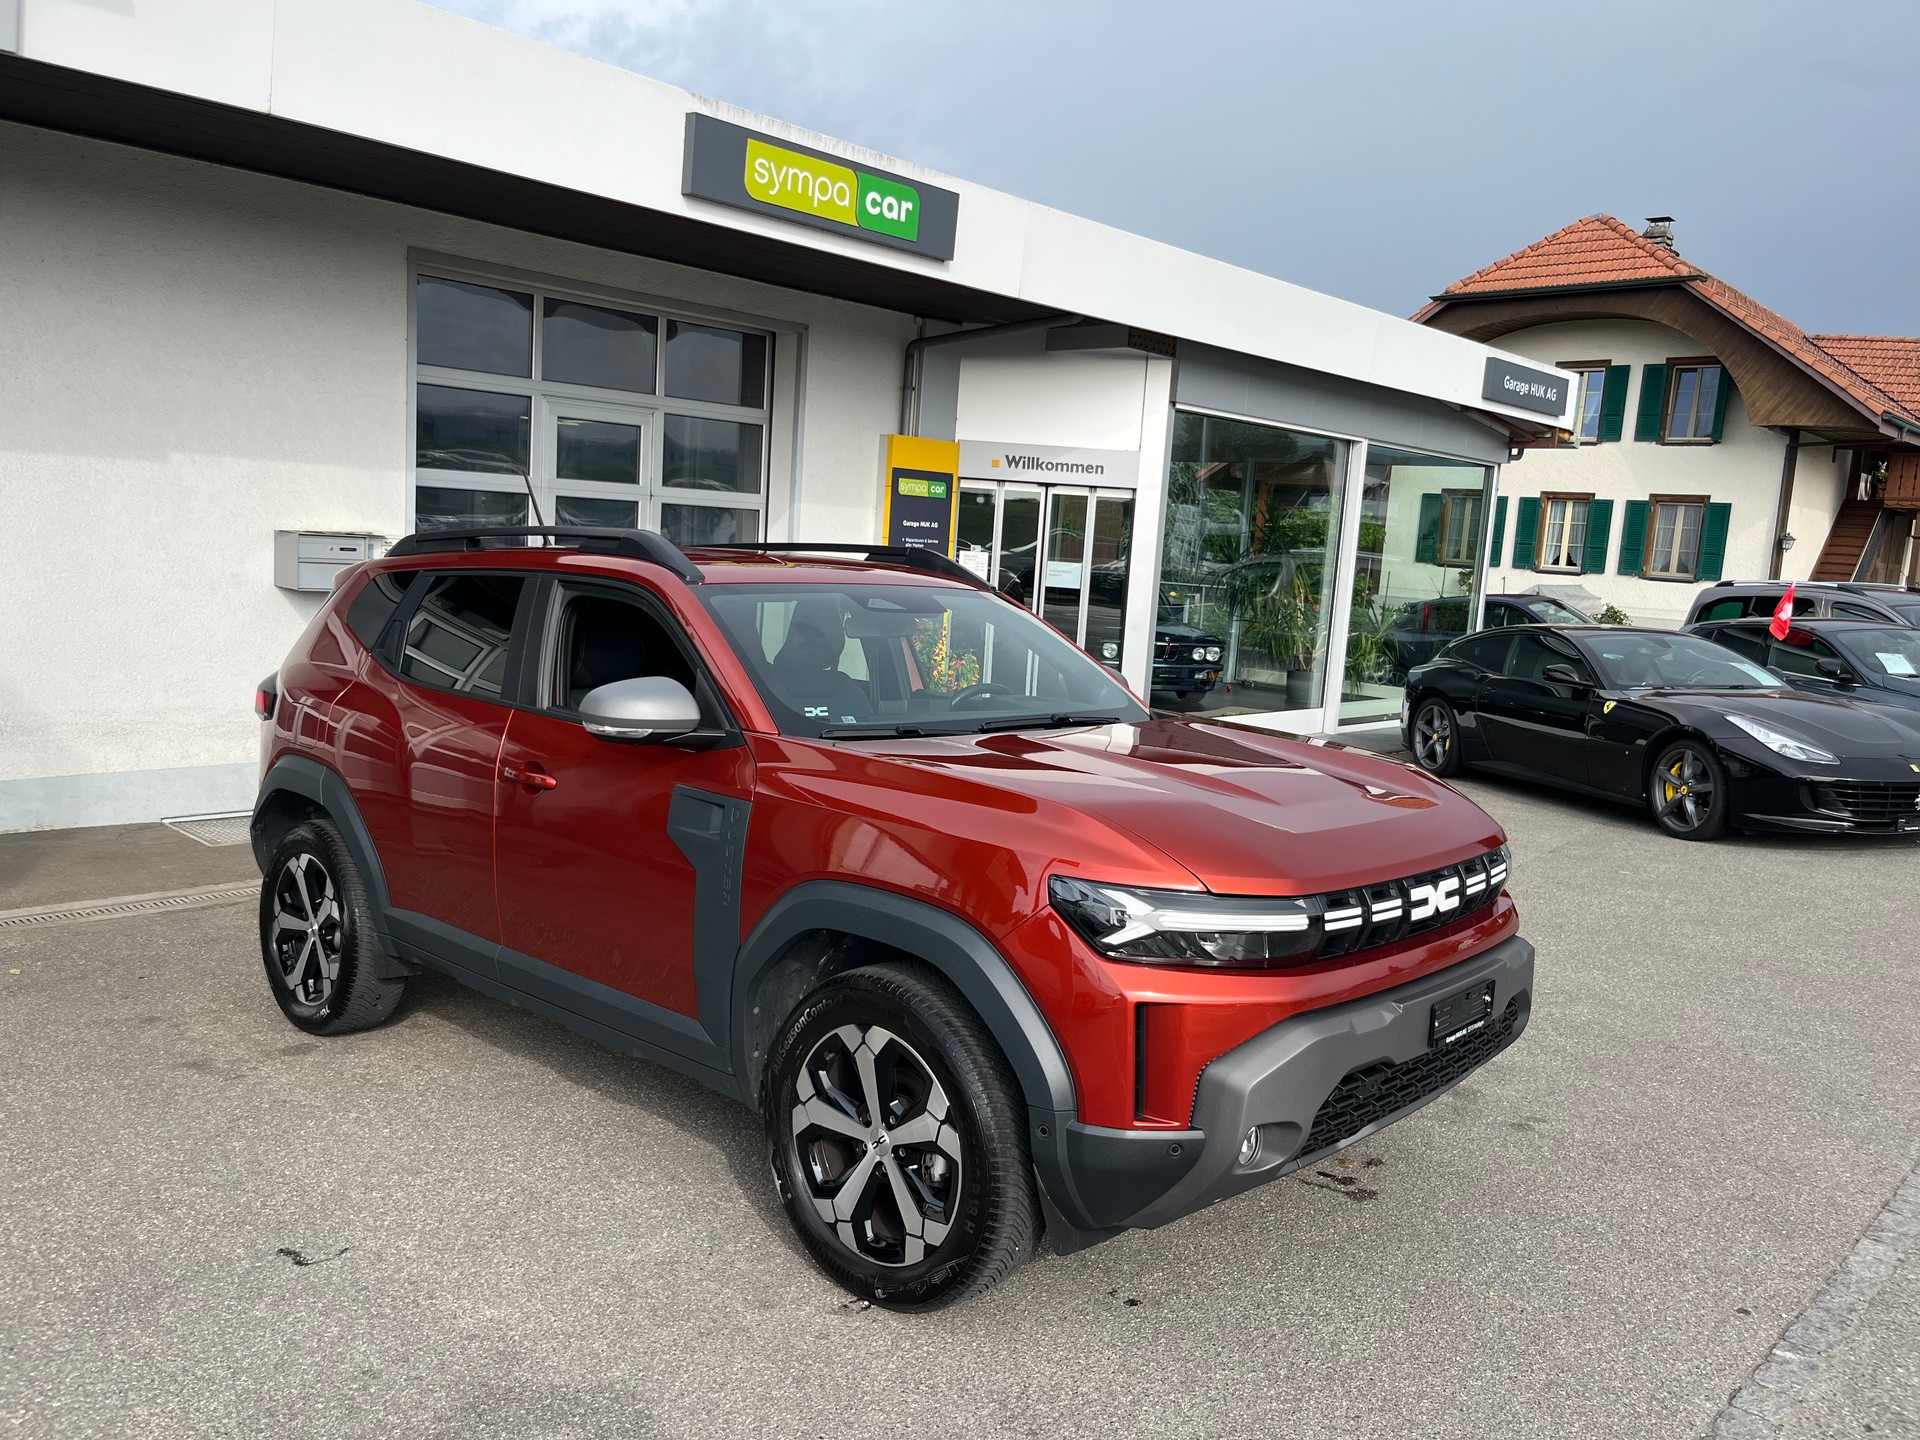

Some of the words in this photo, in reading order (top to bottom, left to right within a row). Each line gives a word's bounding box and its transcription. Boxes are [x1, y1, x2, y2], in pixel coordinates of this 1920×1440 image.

[754, 158, 850, 207] sympa
[865, 191, 913, 222] car
[1504, 376, 1529, 395] Garage
[1530, 383, 1545, 398] HUK
[1546, 387, 1557, 401] AG
[1005, 454, 1105, 475] Willkommen
[900, 482, 927, 493] sympa
[930, 485, 945, 493] car
[902, 520, 919, 528] Garage
